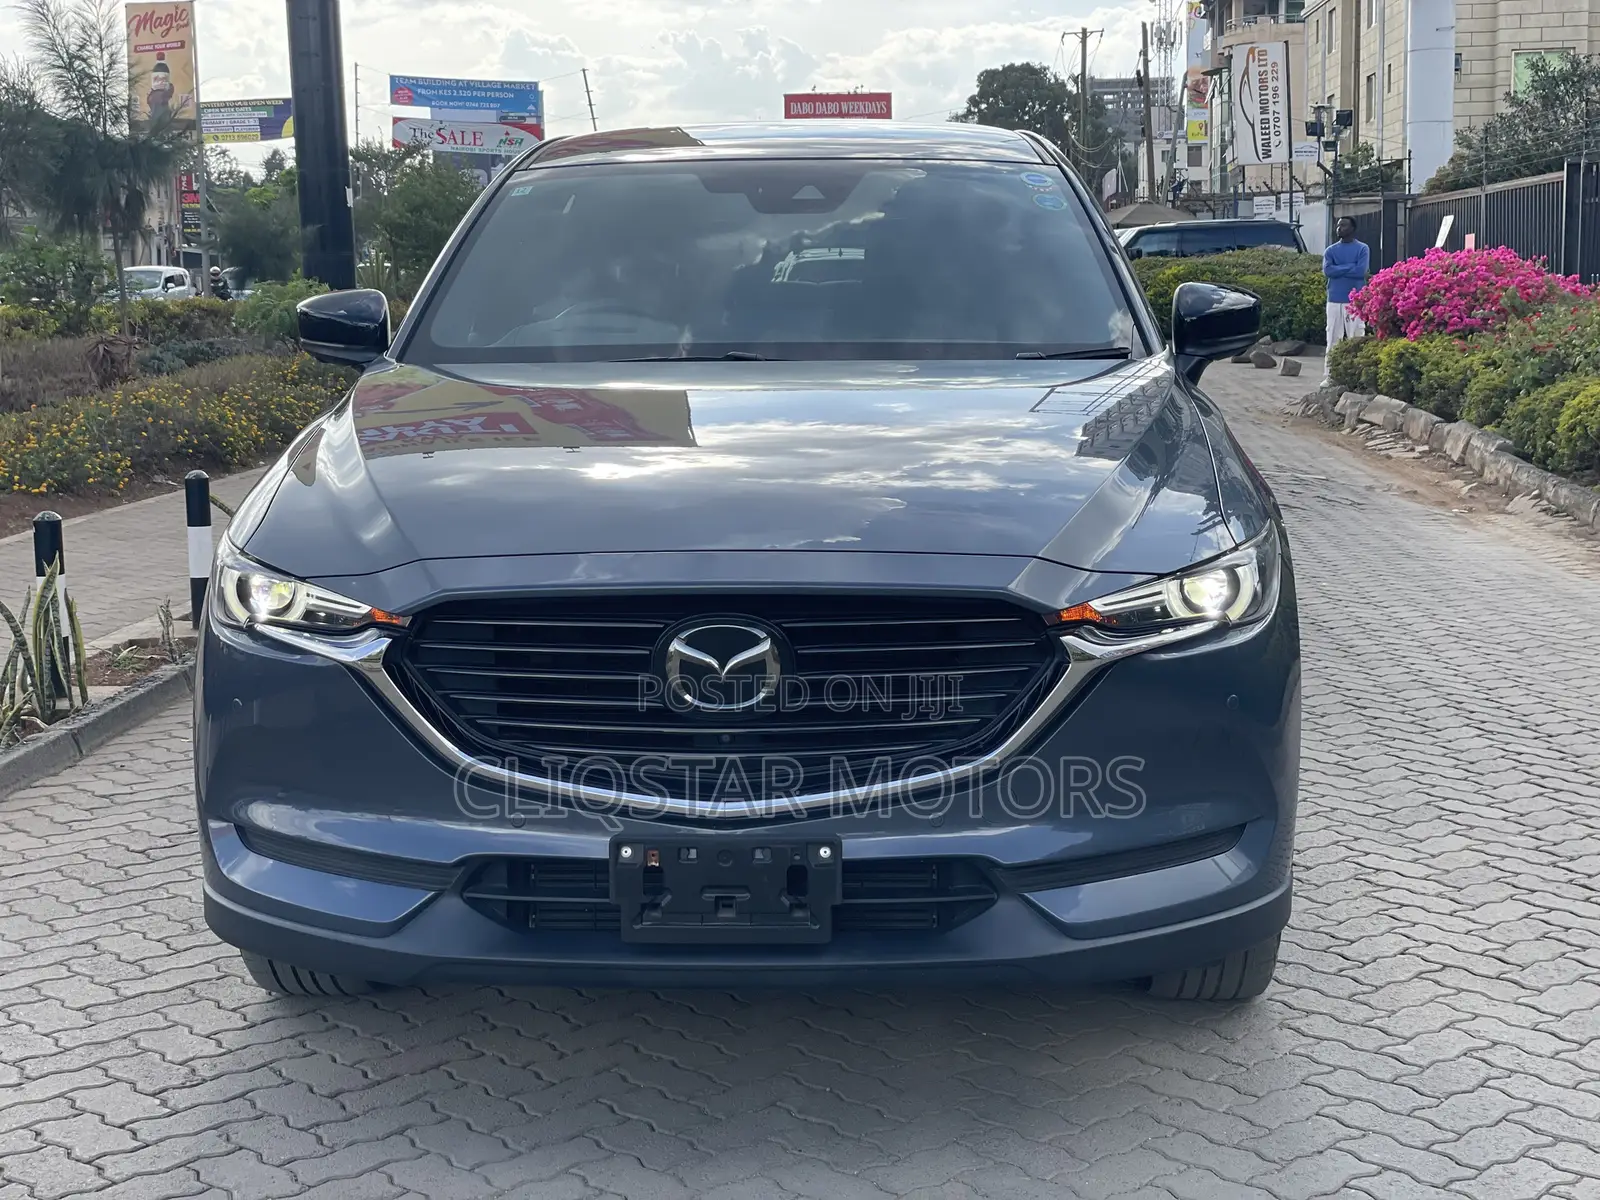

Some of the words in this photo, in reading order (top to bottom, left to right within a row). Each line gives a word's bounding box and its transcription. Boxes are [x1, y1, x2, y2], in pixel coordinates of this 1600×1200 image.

[128, 4, 189, 38] Magic
[1257, 49, 1268, 68] LTD
[1270, 61, 1279, 82] 229
[395, 77, 416, 85] TEAM
[469, 81, 501, 89] VILLAGE
[417, 88, 438, 96] FROM
[1257, 69, 1270, 116] MOTORS
[1271, 85, 1280, 106] 196
[790, 102, 815, 115] DABO
[815, 101, 840, 115] DABO
[840, 101, 887, 114] WEEKDAYS
[1272, 109, 1281, 137] 0707
[409, 127, 434, 139] The
[435, 126, 484, 146] SALE
[1260, 117, 1272, 160] WALEED
